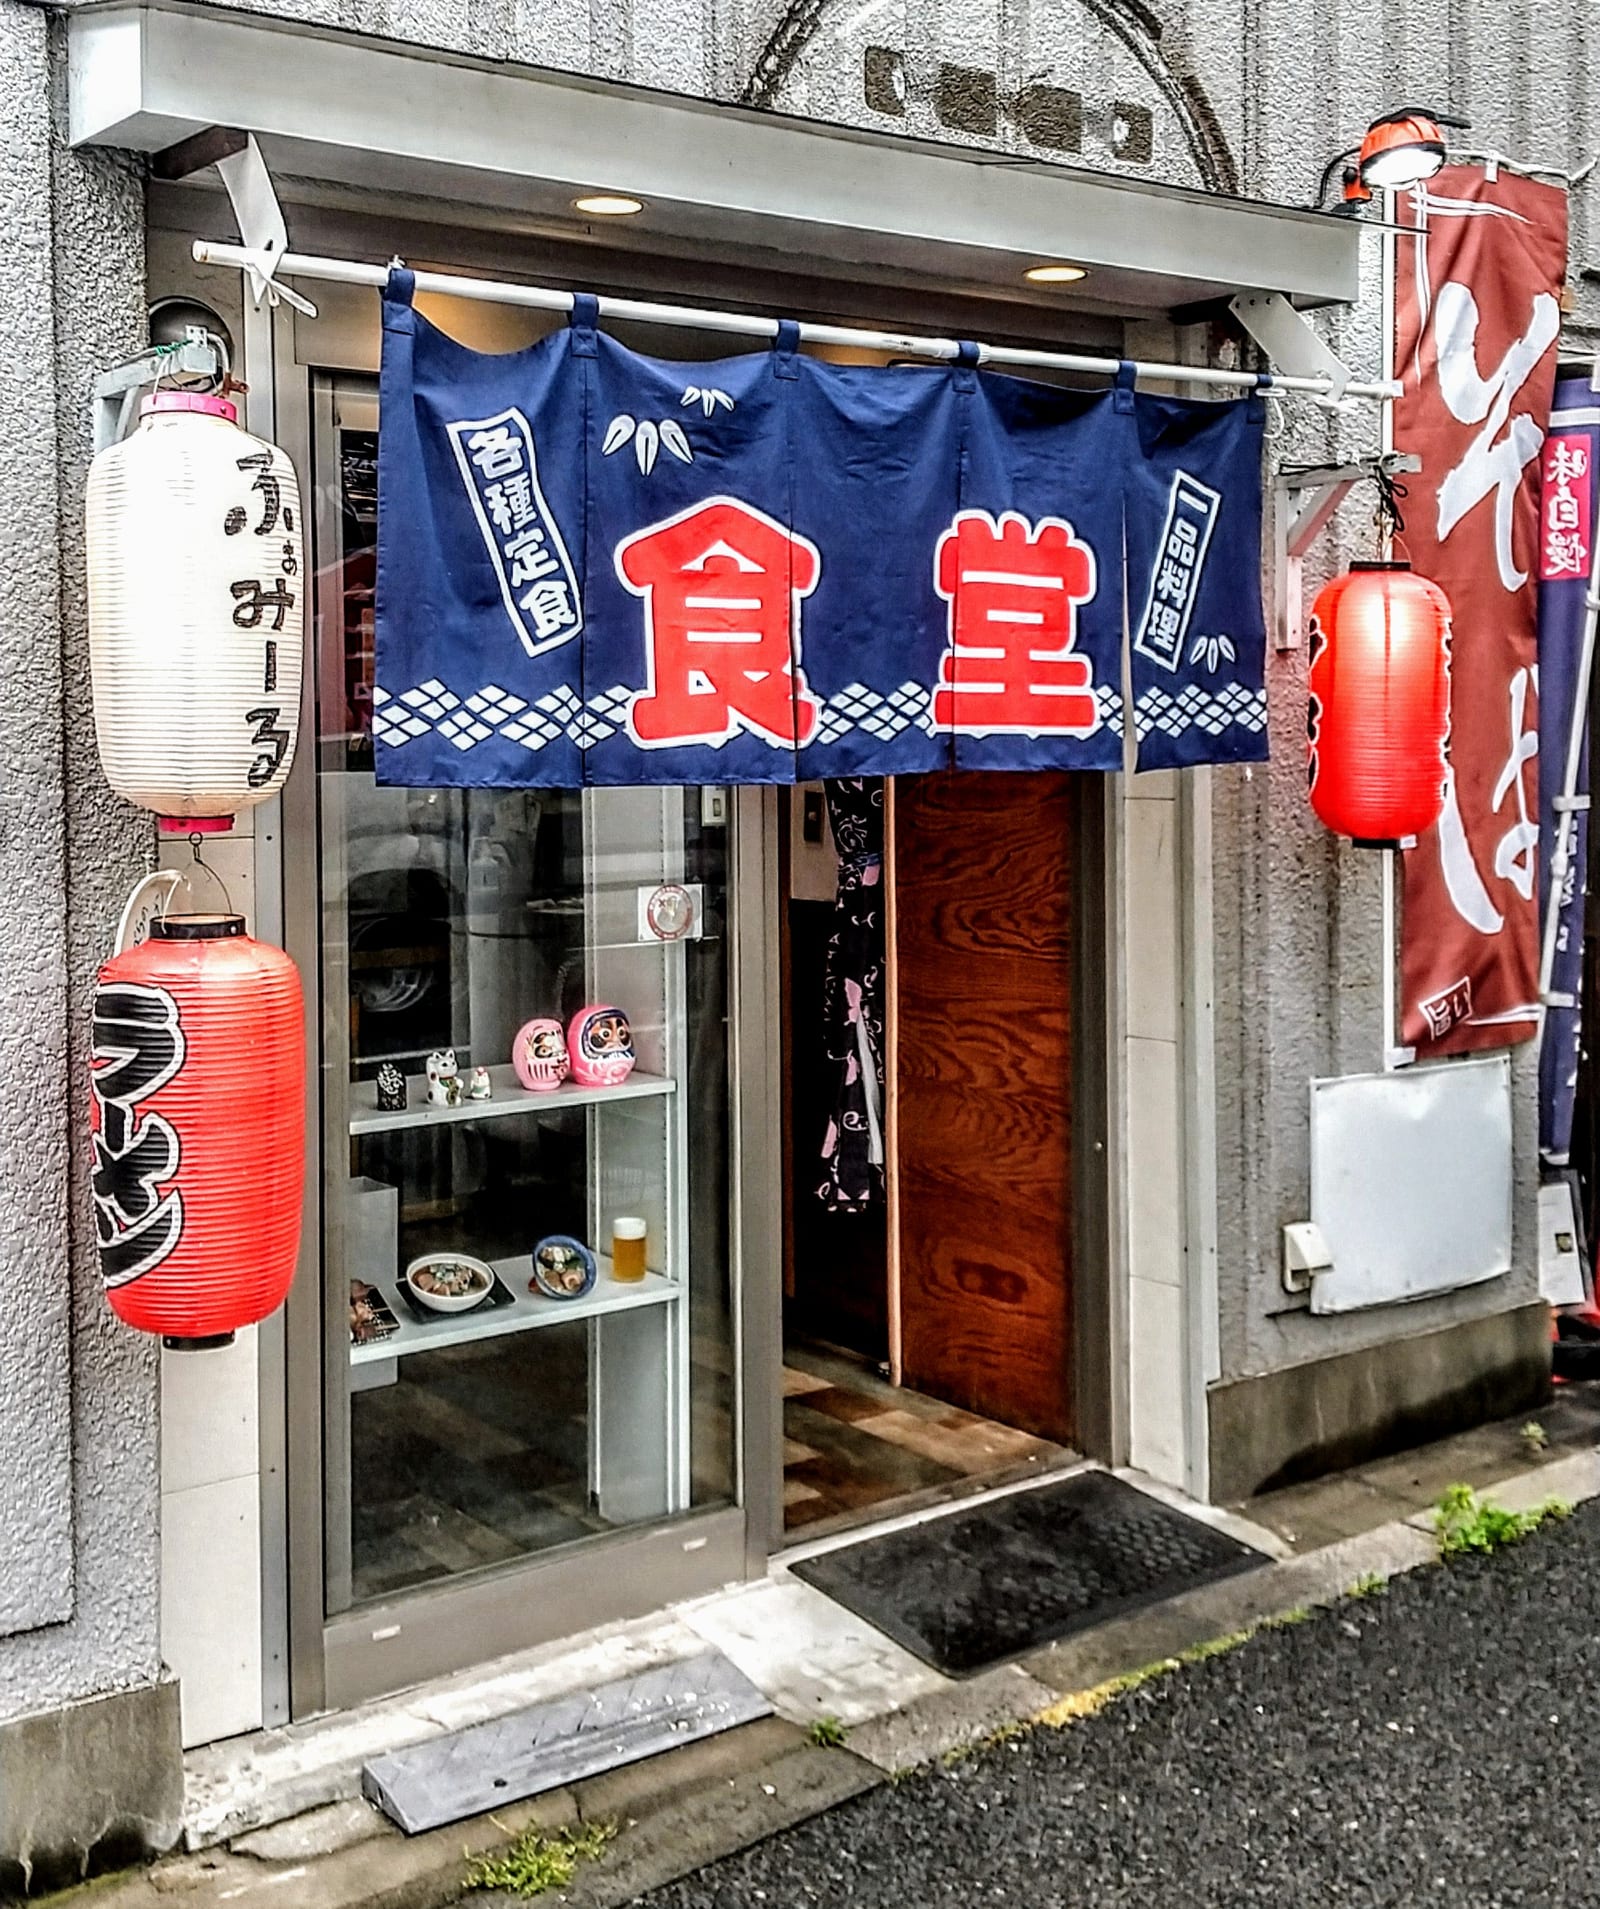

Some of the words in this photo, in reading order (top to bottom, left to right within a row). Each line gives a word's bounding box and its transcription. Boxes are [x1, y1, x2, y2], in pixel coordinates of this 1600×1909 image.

[466, 425, 577, 640] 各種定食
[613, 495, 1100, 750] 食堂
[1147, 489, 1209, 653] 一品料理
